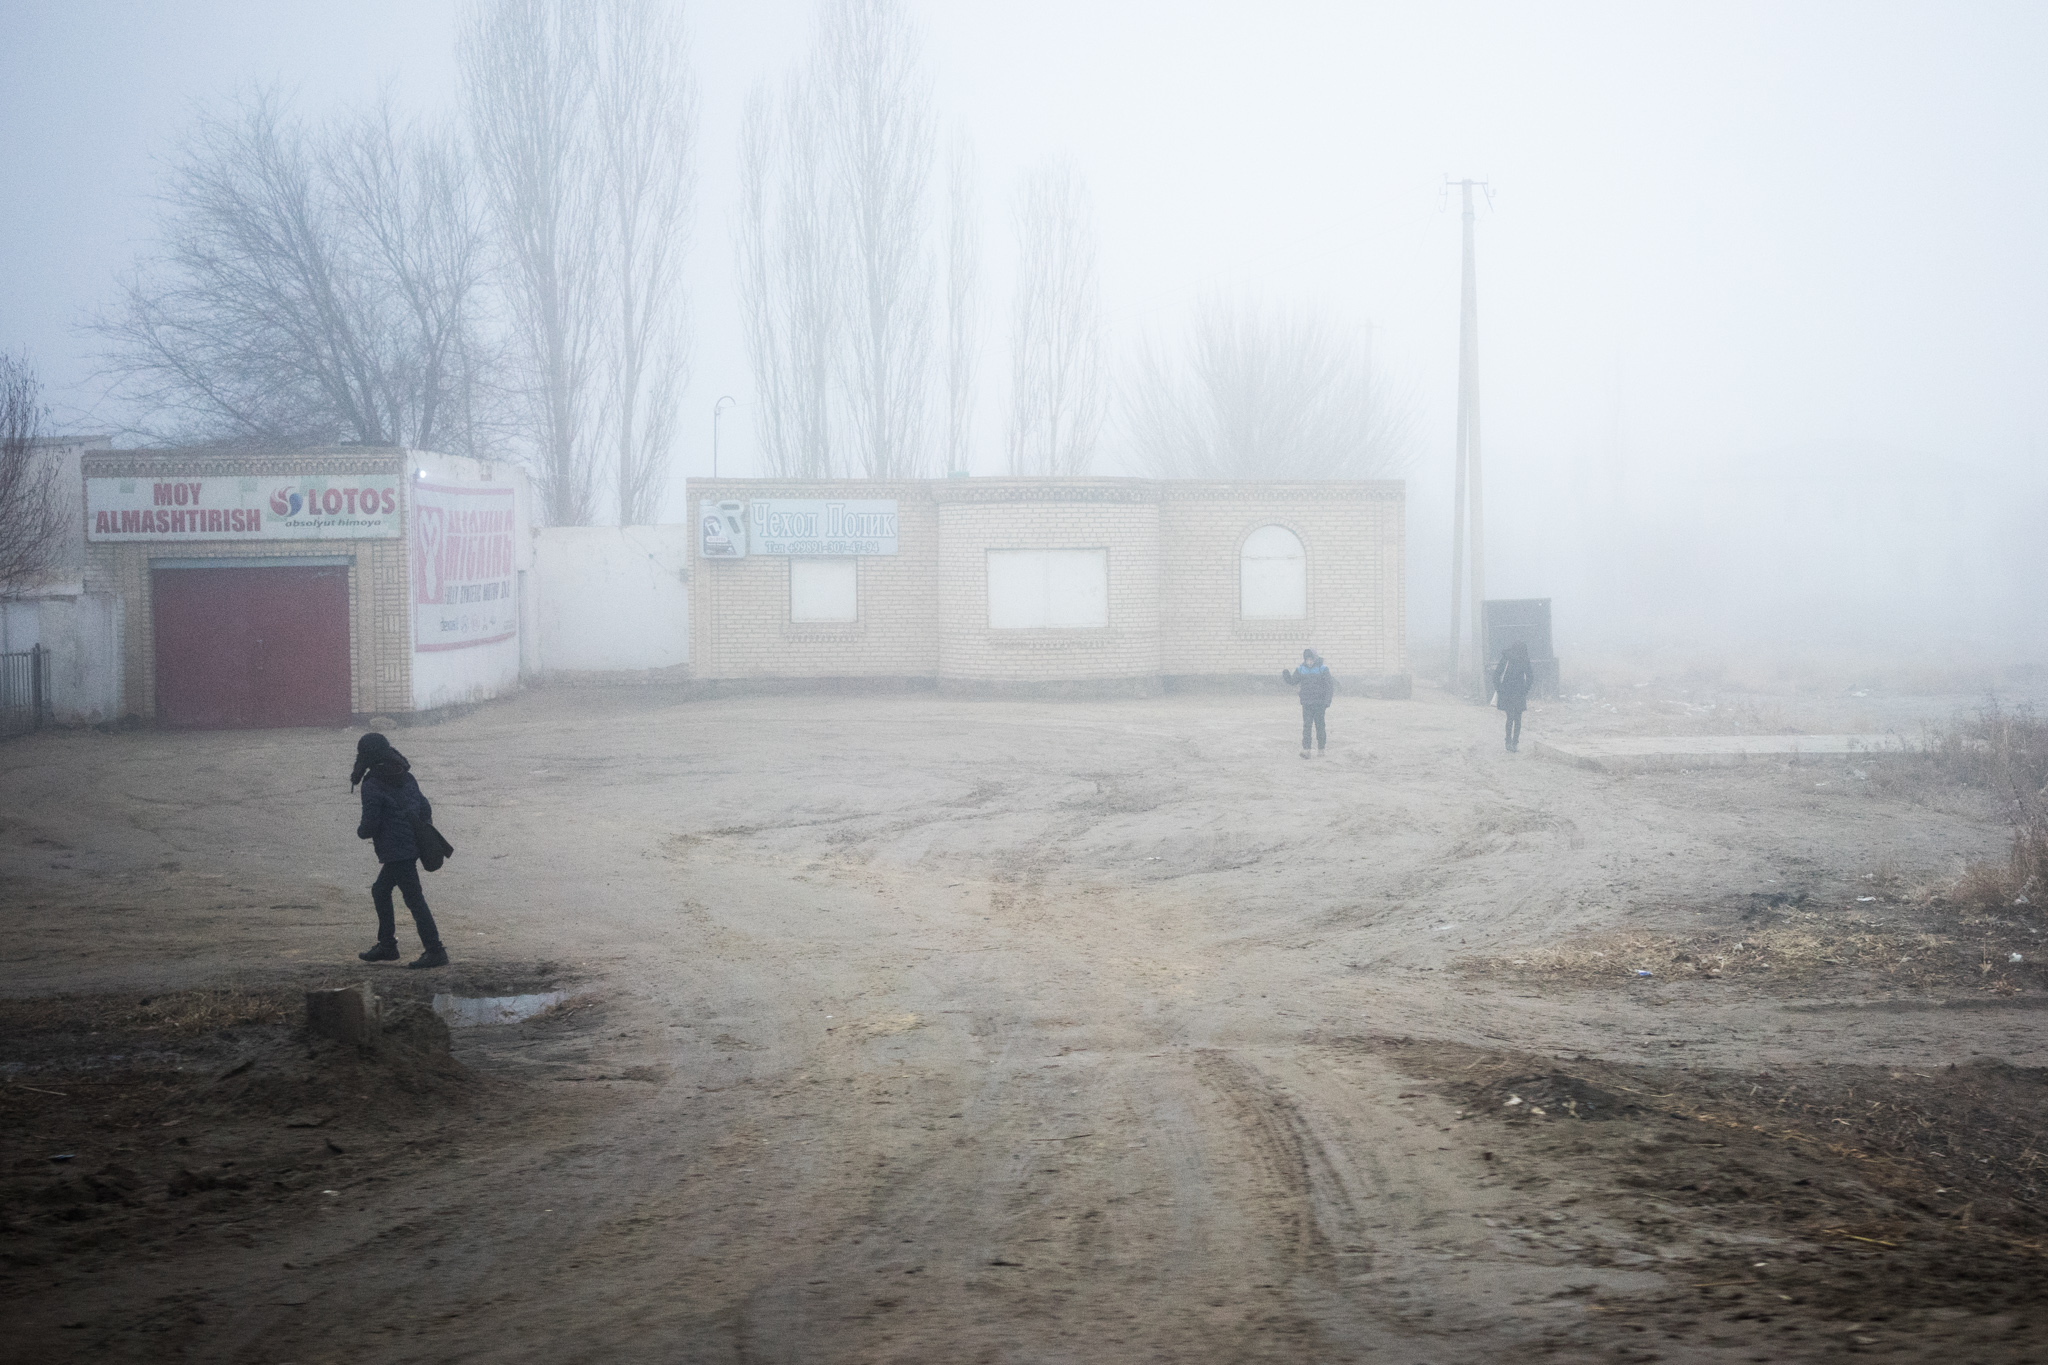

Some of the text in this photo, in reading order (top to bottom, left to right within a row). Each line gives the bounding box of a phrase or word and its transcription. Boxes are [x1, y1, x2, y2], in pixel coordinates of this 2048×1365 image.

[153, 482, 202, 507] MOY
[309, 487, 396, 515] LOTOS
[95, 508, 261, 534] ALMASHTIRISH
[285, 517, 382, 530] absolyut himoya
[752, 502, 895, 538] Чехол Полик
[765, 541, 786, 554] Тел
